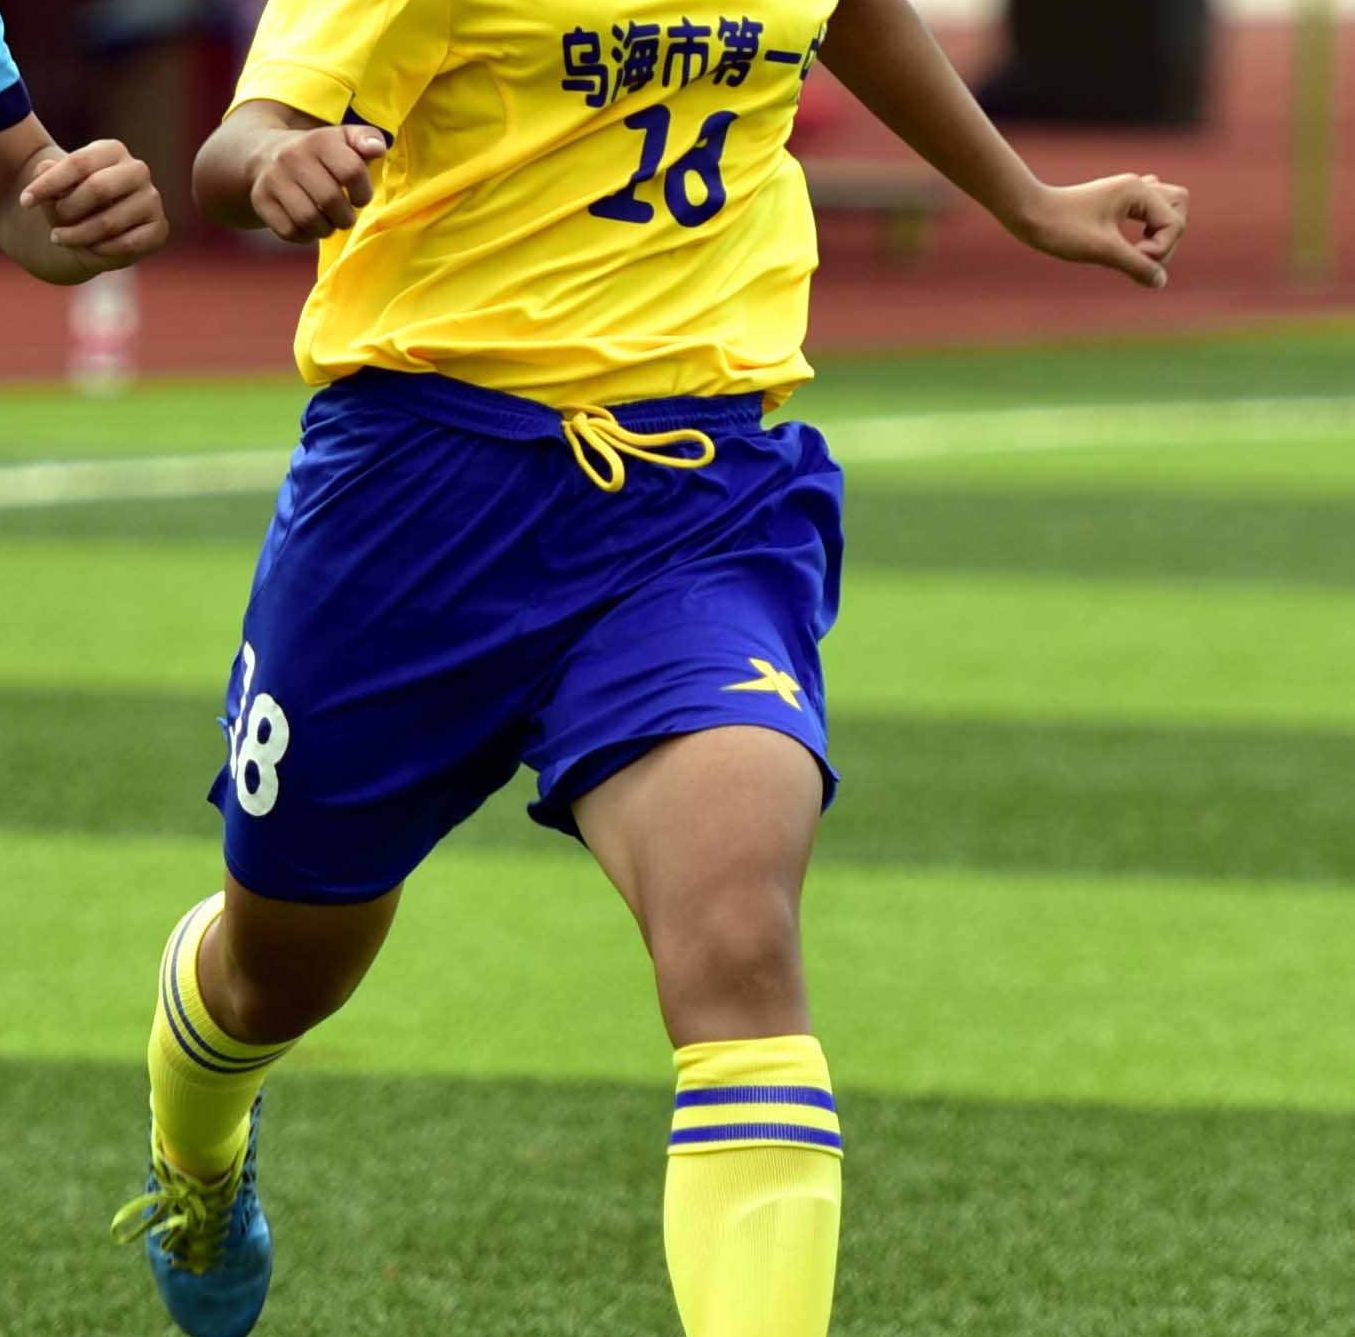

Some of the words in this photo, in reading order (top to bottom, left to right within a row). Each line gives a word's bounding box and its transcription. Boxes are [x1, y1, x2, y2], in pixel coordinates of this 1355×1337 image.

[561, 15, 827, 108] 乌海市第一
